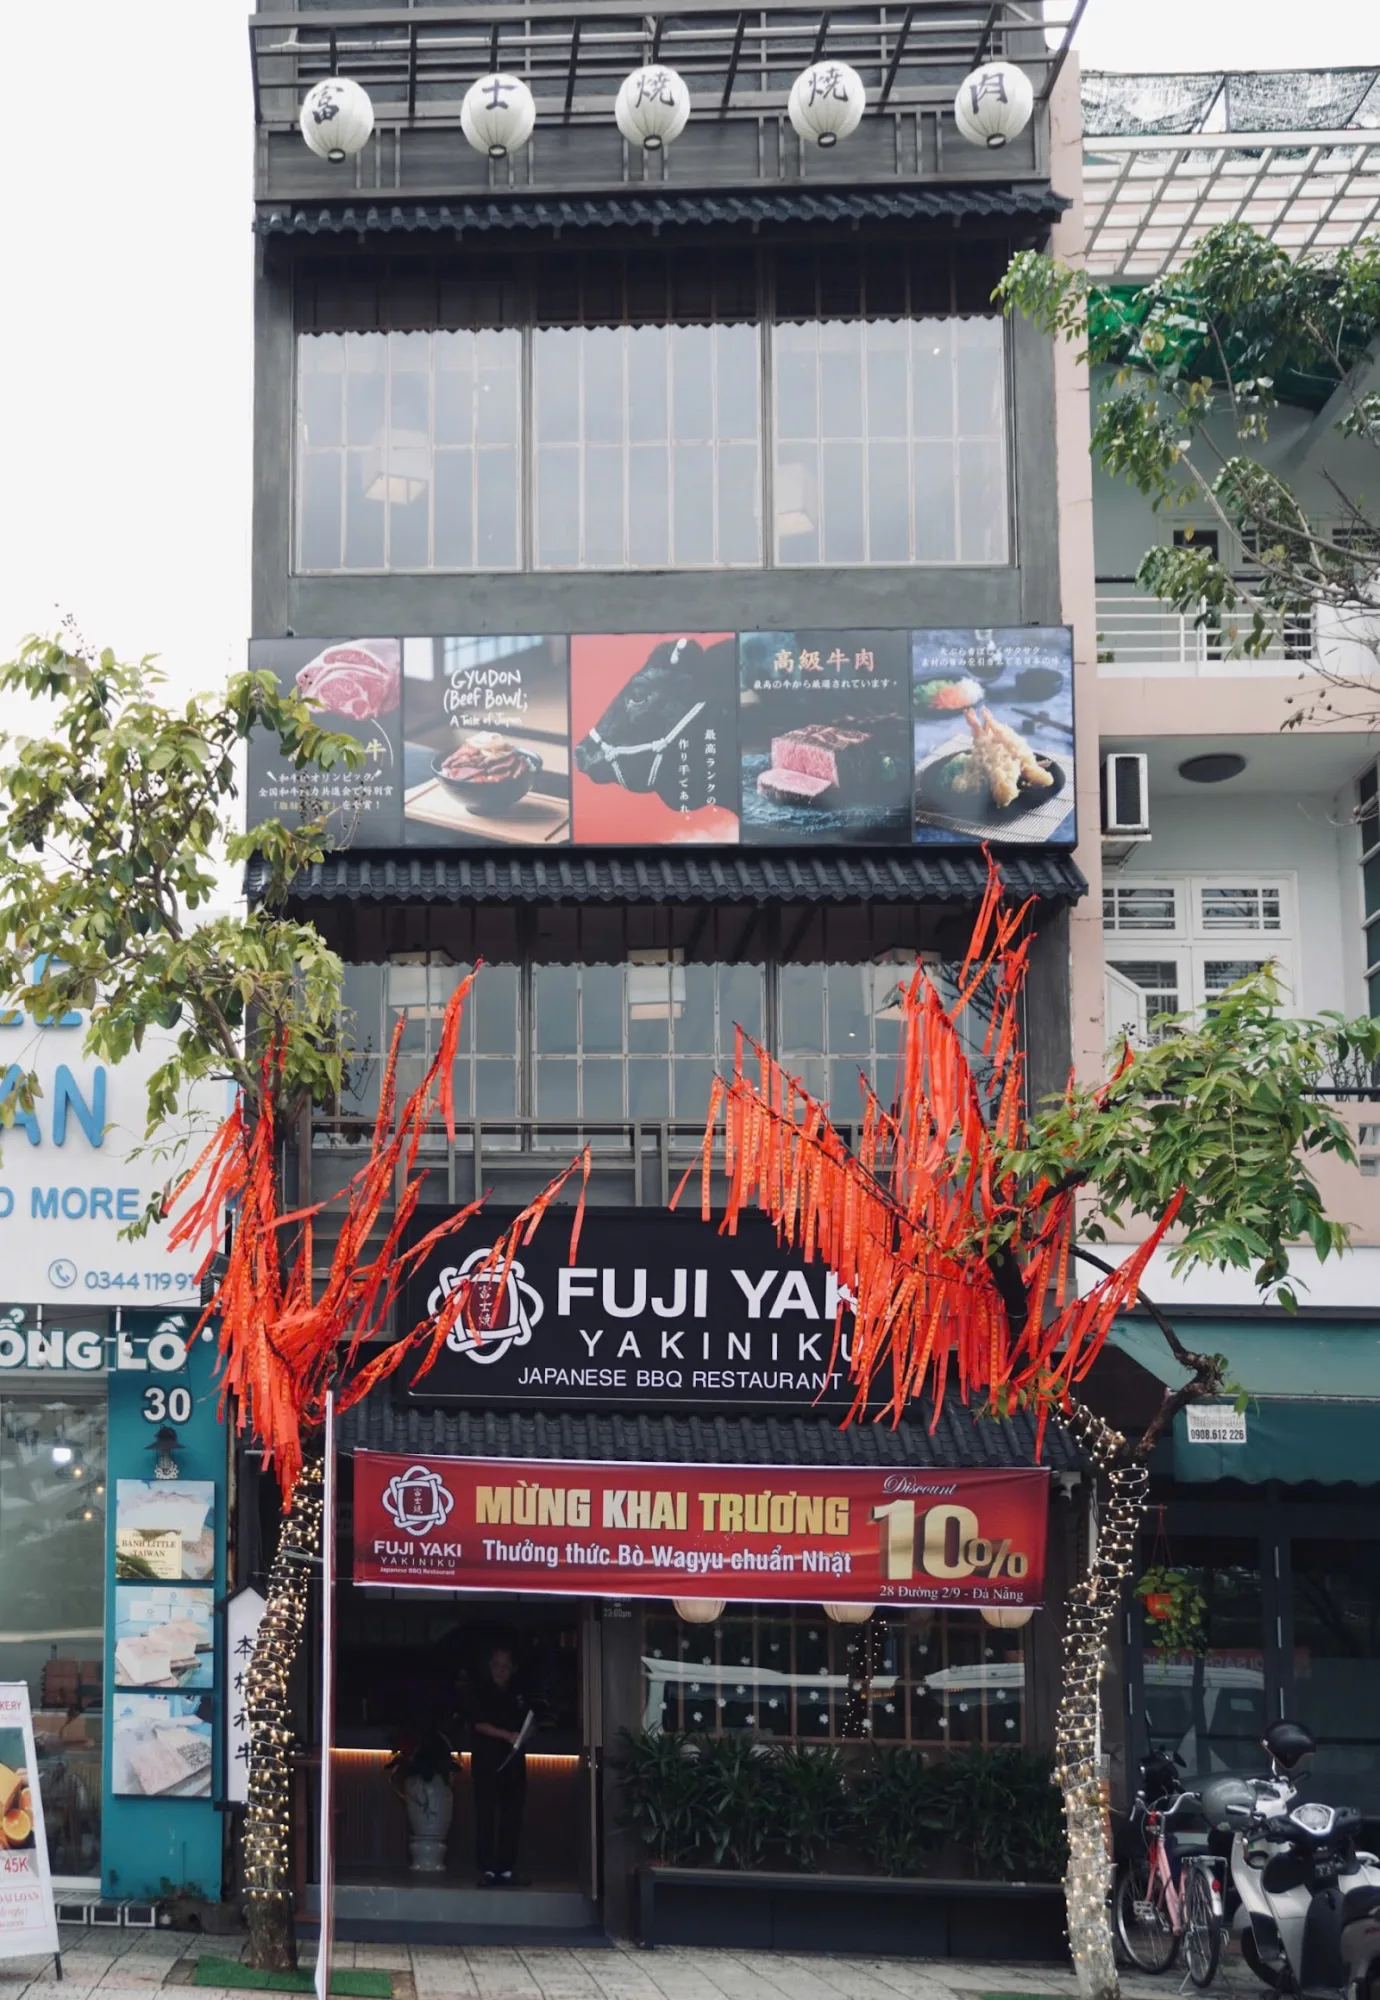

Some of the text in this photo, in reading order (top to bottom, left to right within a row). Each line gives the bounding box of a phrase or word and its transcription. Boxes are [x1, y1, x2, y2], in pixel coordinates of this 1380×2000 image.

[481, 79, 518, 110] 士
[773, 648, 874, 673] 高級牛肉
[31, 1187, 140, 1220] MORE
[557, 1268, 880, 1320] FUJI YAK
[579, 1330, 864, 1362] YAKINIKU
[518, 1367, 843, 1390] JAPANESE BBQ RESTAURANT
[143, 1387, 191, 1422] 30
[882, 1474, 957, 1496] Discount
[475, 1480, 850, 1536] MỪNG KHAI TRƯƠNG
[373, 1540, 462, 1558] FUJI YAKI
[872, 1499, 1028, 1581] 10%
[380, 1556, 456, 1568] YAKINIKU
[380, 1566, 455, 1576] Japanese BBQ Restaurant
[482, 1539, 851, 1578] Thưởng thức Bò Wagyu chuẩn Nhật
[880, 1585, 895, 1597] 28
[898, 1586, 939, 1601] Đường
[942, 1587, 961, 1598] 2/9
[4, 1856, 29, 1874] 45K
